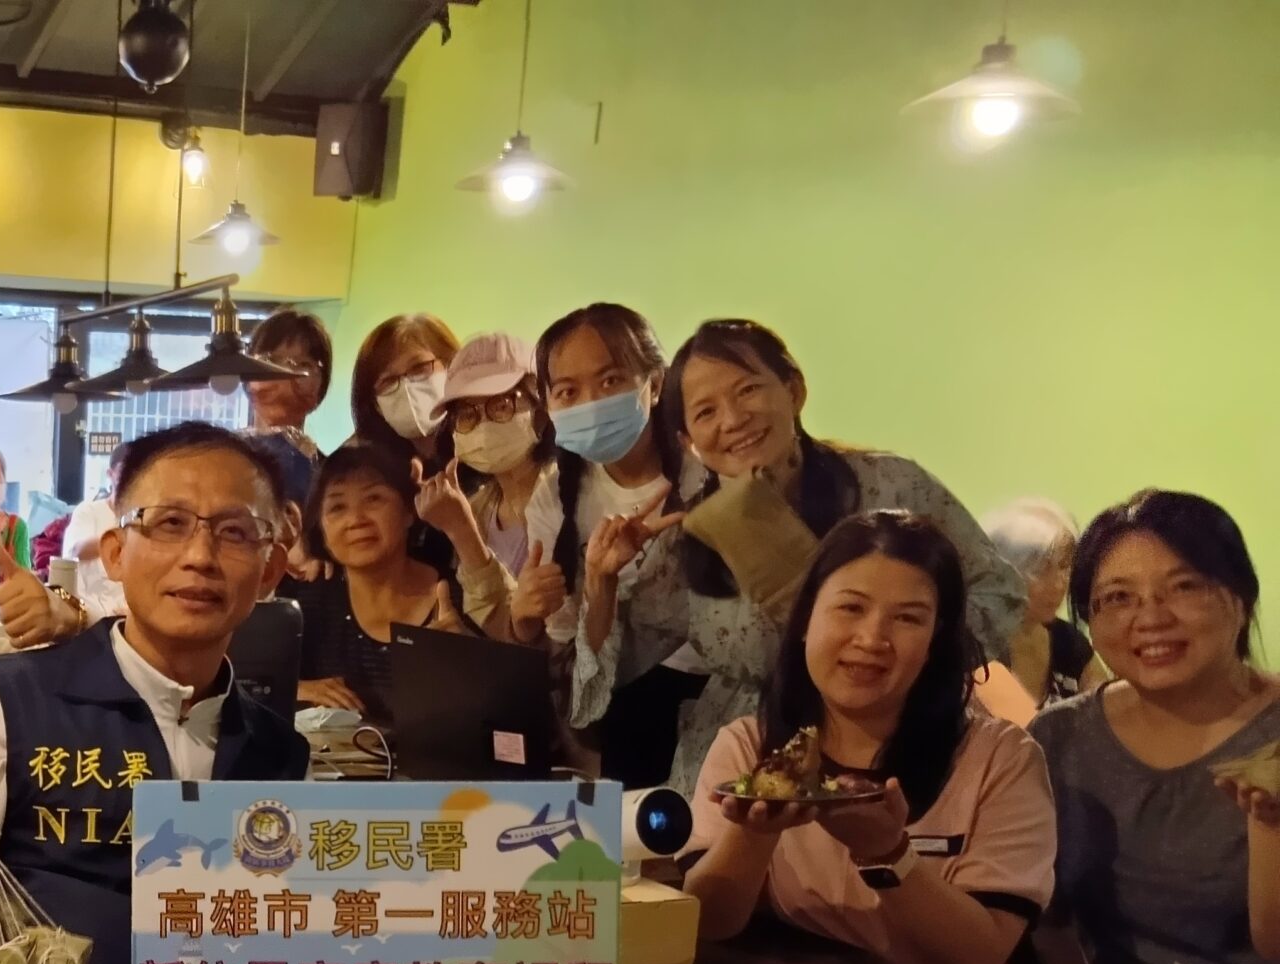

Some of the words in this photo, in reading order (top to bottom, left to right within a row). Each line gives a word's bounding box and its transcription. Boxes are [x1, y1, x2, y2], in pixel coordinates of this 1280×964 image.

[28, 746, 153, 791] 移民署
[308, 819, 468, 872] 移民署
[157, 888, 312, 939] 高雄市
[331, 888, 598, 940] 第一服務站
